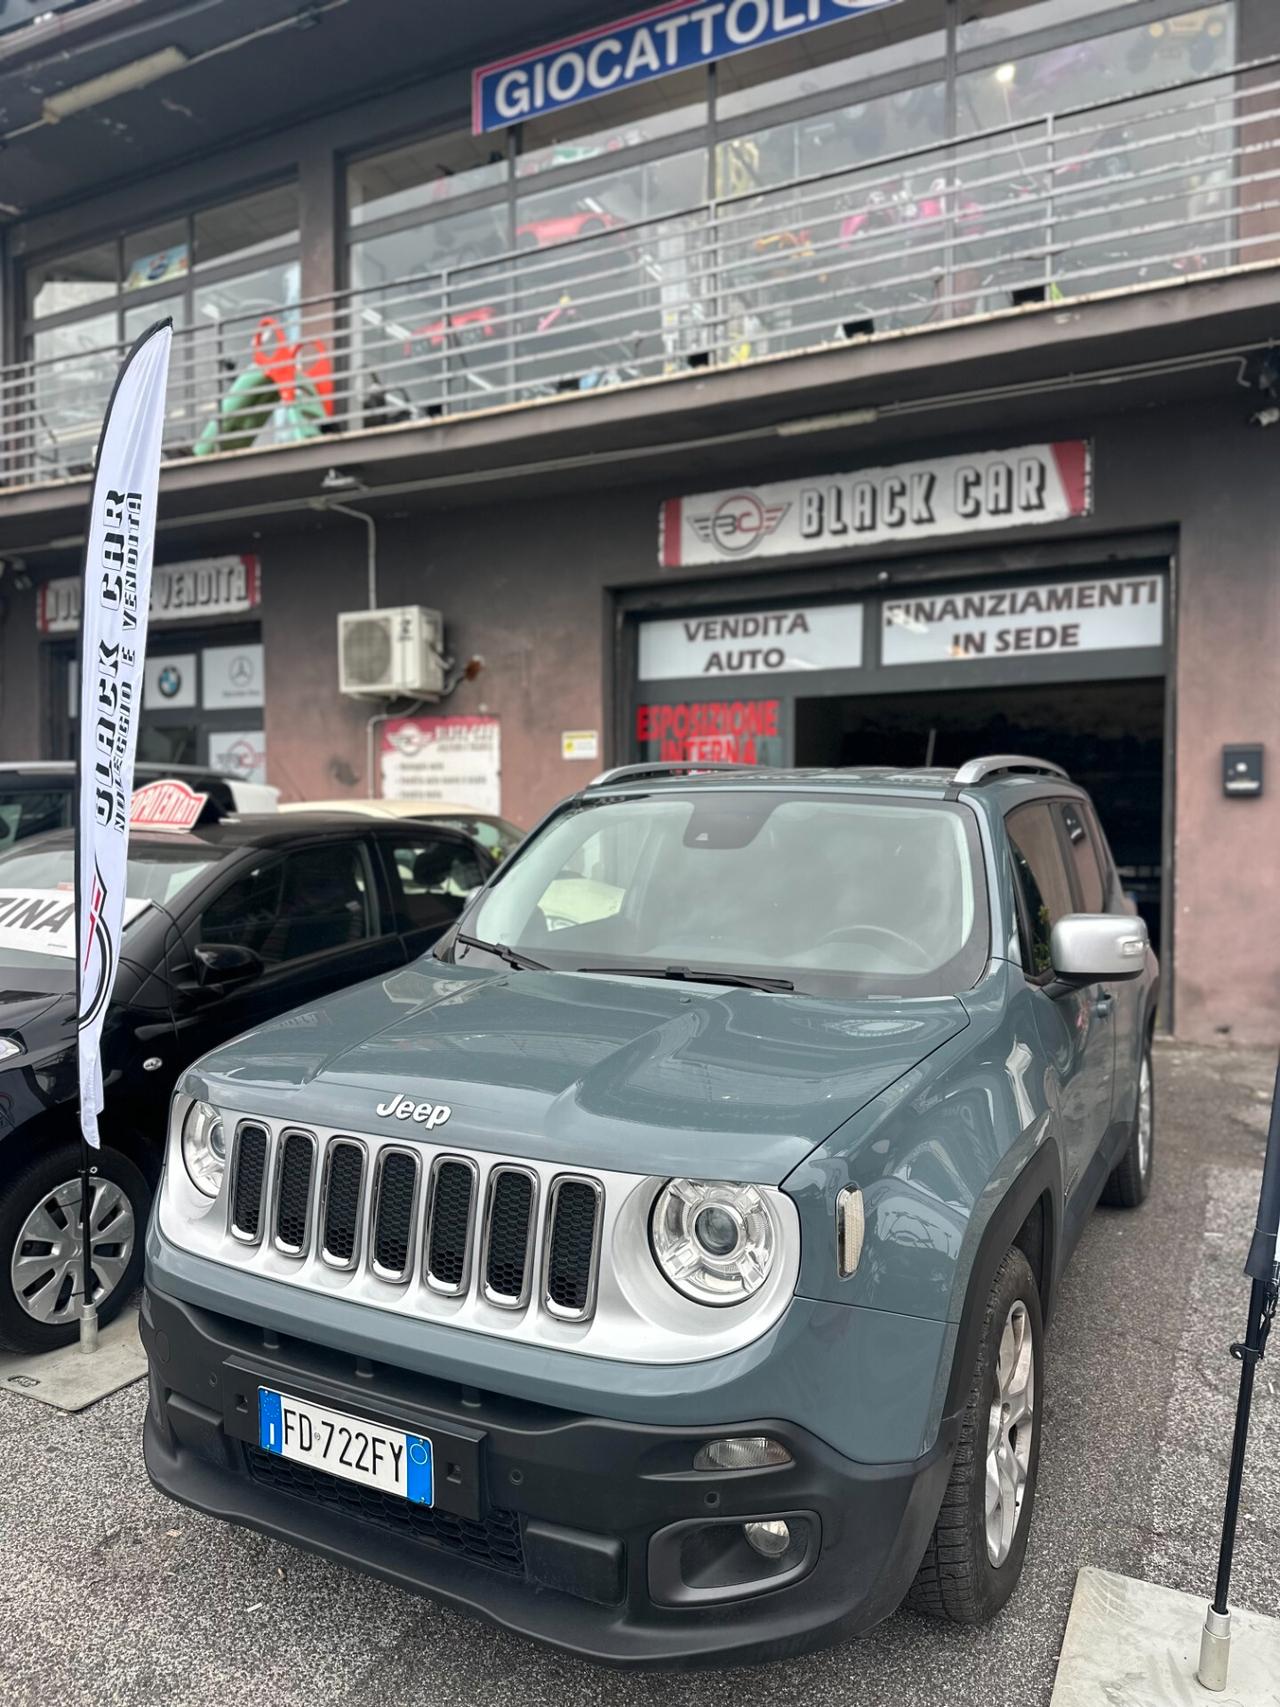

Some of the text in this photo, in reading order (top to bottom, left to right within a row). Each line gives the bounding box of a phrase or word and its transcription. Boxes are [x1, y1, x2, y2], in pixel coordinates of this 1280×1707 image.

[801, 456, 1046, 539] BLACK CAR
[122, 492, 142, 631] VENDITA
[886, 579, 1159, 626] FINANZIAMENTI
[684, 612, 810, 642] VENDITA
[952, 624, 1081, 655] IN SEDE
[95, 490, 125, 827] BLACK CAR
[121, 646, 135, 667] E
[704, 647, 784, 673] AUTO
[636, 699, 779, 741] ESPOSIZIONE
[376, 1093, 452, 1130] Jeep
